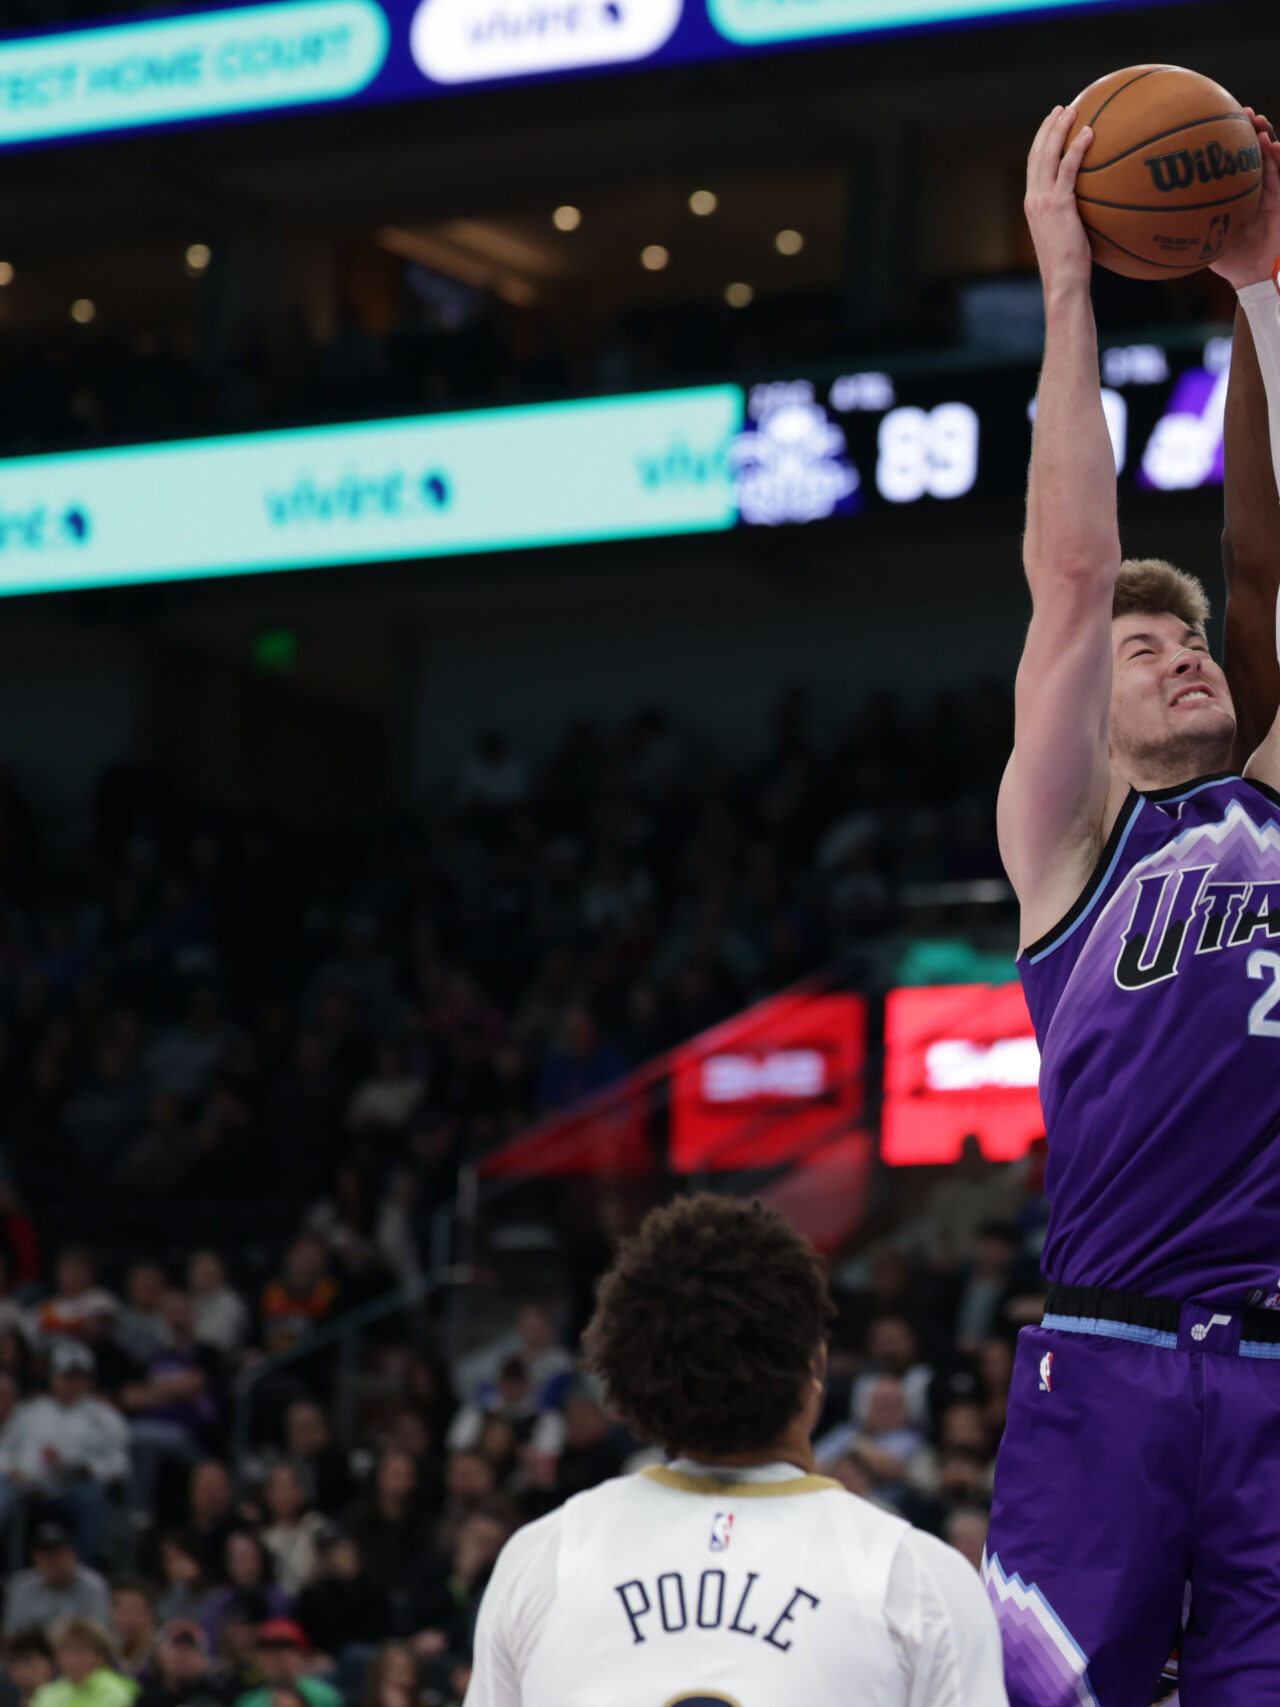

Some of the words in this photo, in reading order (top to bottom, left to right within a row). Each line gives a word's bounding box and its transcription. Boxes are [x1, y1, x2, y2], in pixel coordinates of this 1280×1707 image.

[86, 45, 203, 93] HOME
[215, 23, 350, 83] COURT
[1144, 140, 1262, 193] Wilson
[876, 402, 979, 502] 89
[614, 1569, 821, 1653] POOLE
